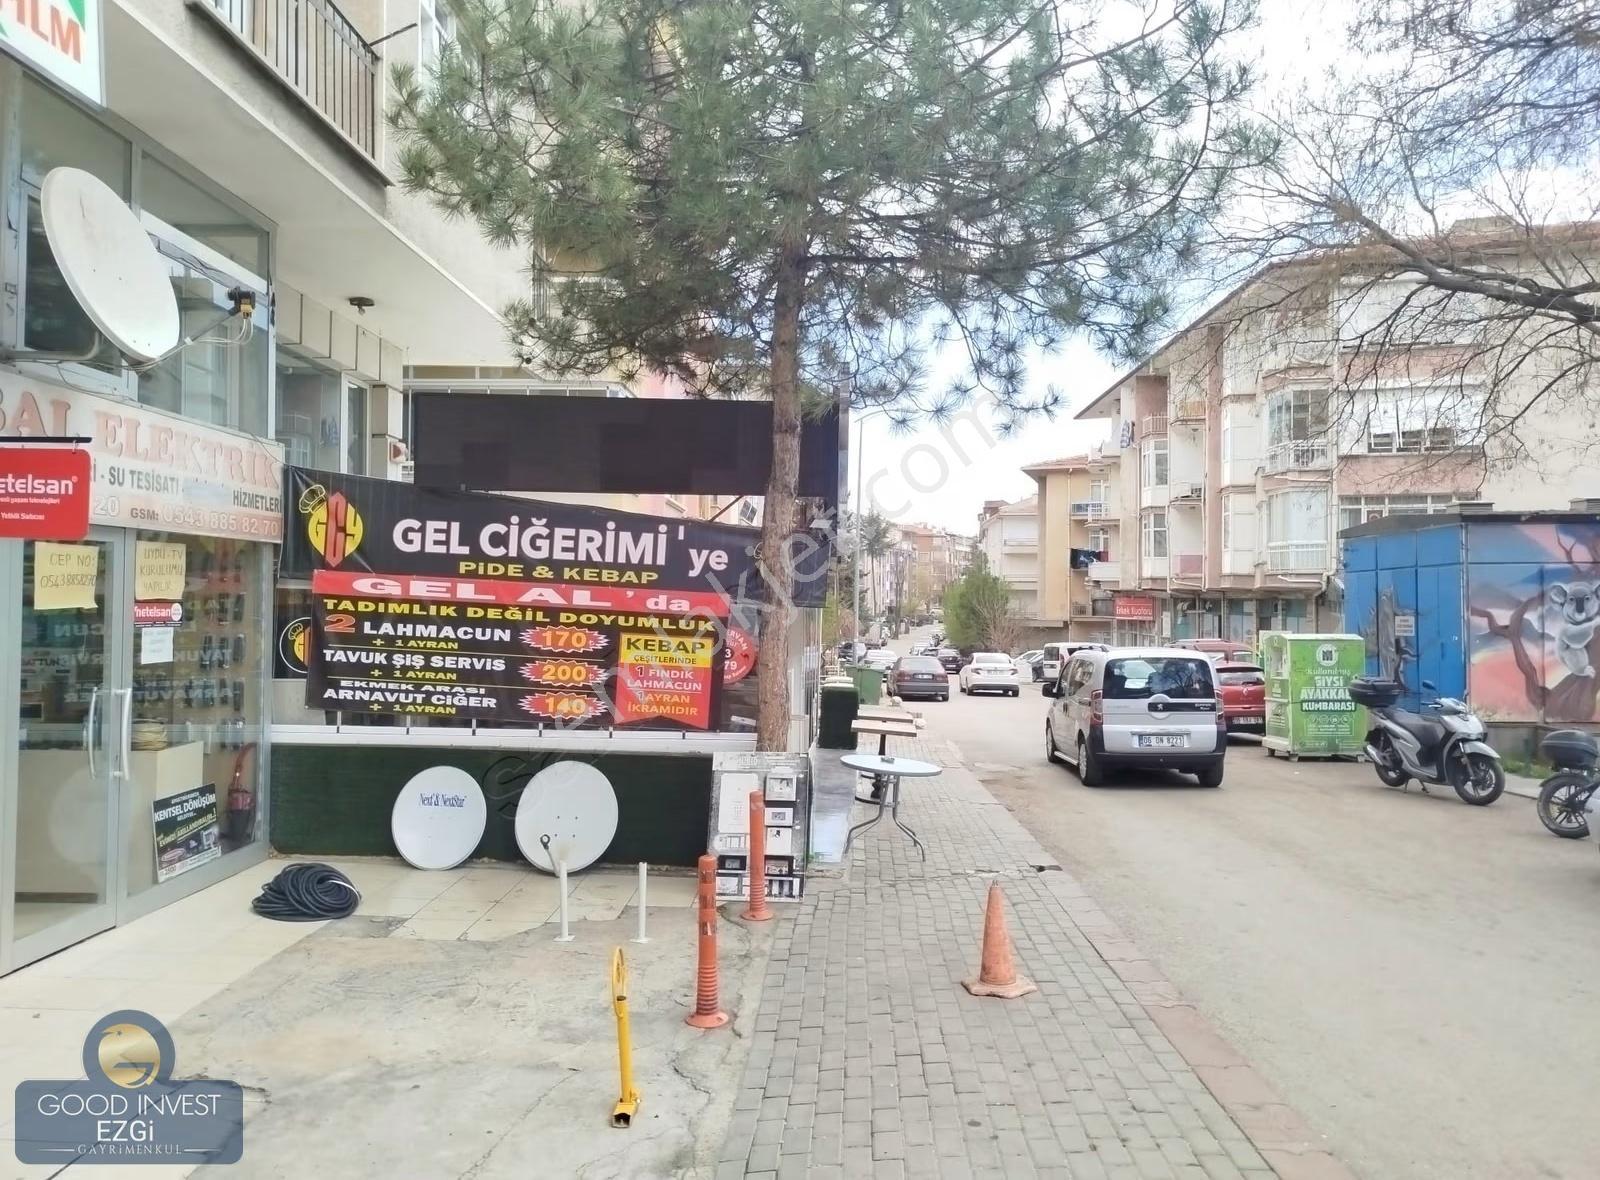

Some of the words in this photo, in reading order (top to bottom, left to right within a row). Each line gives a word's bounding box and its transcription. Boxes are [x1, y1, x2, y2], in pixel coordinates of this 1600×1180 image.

[108, 465, 125, 487] SU
[129, 468, 180, 496] TESİSATI
[130, 507, 159, 522] GSM:
[209, 511, 237, 532] 885
[242, 517, 258, 534] 82
[263, 520, 279, 536] 70
[392, 518, 470, 555] GEL
[50, 553, 71, 568] CEP
[532, 564, 554, 579] &
[563, 567, 659, 584] KEBAP
[352, 578, 496, 601] GEL
[323, 599, 458, 617] TADIMLIK
[466, 606, 550, 622] DEĞİL
[559, 613, 716, 632] DOYUMLUK
[324, 613, 356, 633] 2
[363, 621, 512, 642] LAHMACUN
[542, 631, 587, 648] 170
[407, 639, 459, 650] AYRAN
[626, 638, 705, 654] KEBAP
[323, 649, 388, 665] TAVUK
[542, 664, 587, 681] 200
[405, 671, 457, 681] AYRAN
[648, 669, 694, 680] FINDIK
[340, 680, 415, 691] EKMEK
[420, 684, 486, 695] ARASI
[627, 679, 702, 691] LAHMACUN
[323, 688, 426, 704] ARNAVUT
[545, 696, 586, 714] 140
[645, 693, 690, 704] AYRAN
[1302, 701, 1356, 711] KUMBARASI
[405, 704, 456, 714] AYRAN
[154, 804, 184, 823] KENTSEL
